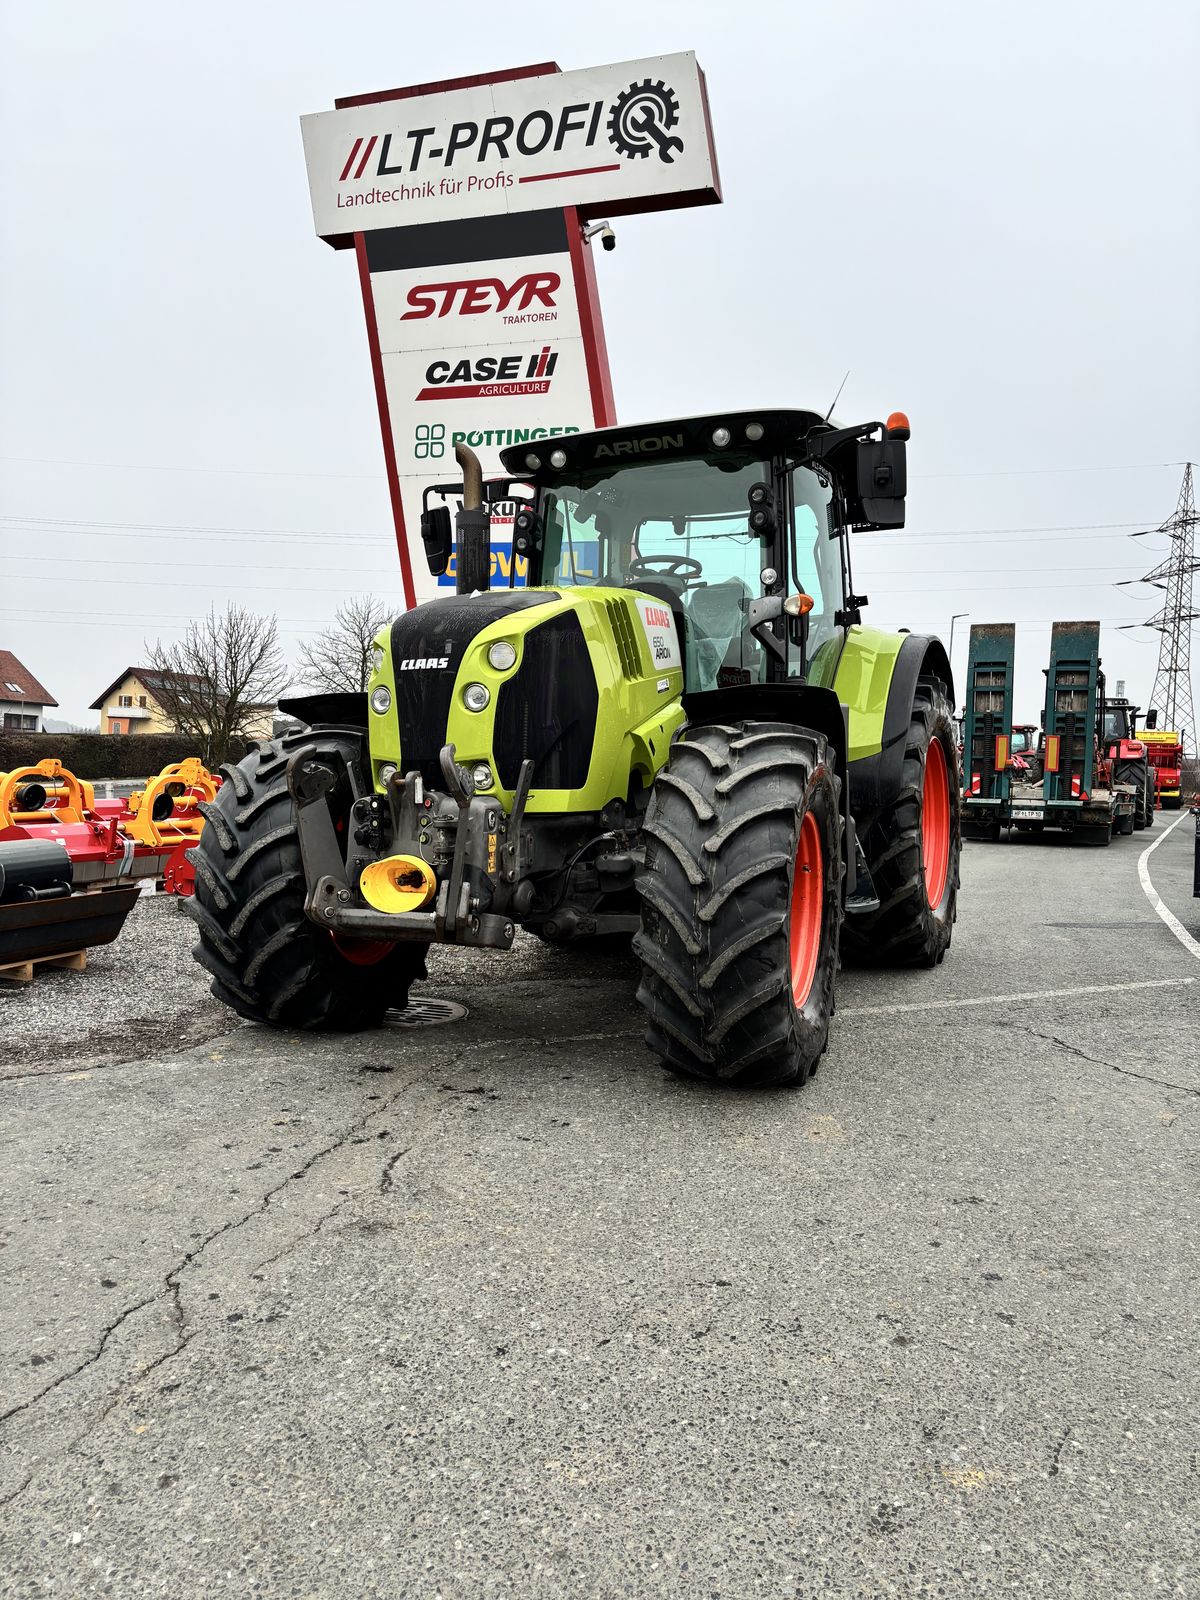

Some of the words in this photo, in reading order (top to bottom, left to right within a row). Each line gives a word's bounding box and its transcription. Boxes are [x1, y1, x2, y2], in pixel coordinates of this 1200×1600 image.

[336, 181, 436, 209] Landtechnik
[439, 178, 463, 196] für
[466, 170, 514, 191] Profis
[399, 271, 561, 321] STEYR
[502, 311, 558, 325] TRAKTOREN
[425, 355, 523, 385] CASE
[478, 382, 547, 396] AGRICULTURE
[593, 433, 684, 459] ARION
[645, 607, 671, 629] CLAAS
[652, 635, 665, 648] 650
[655, 647, 671, 660] ARION
[400, 657, 449, 671] CLAAS
